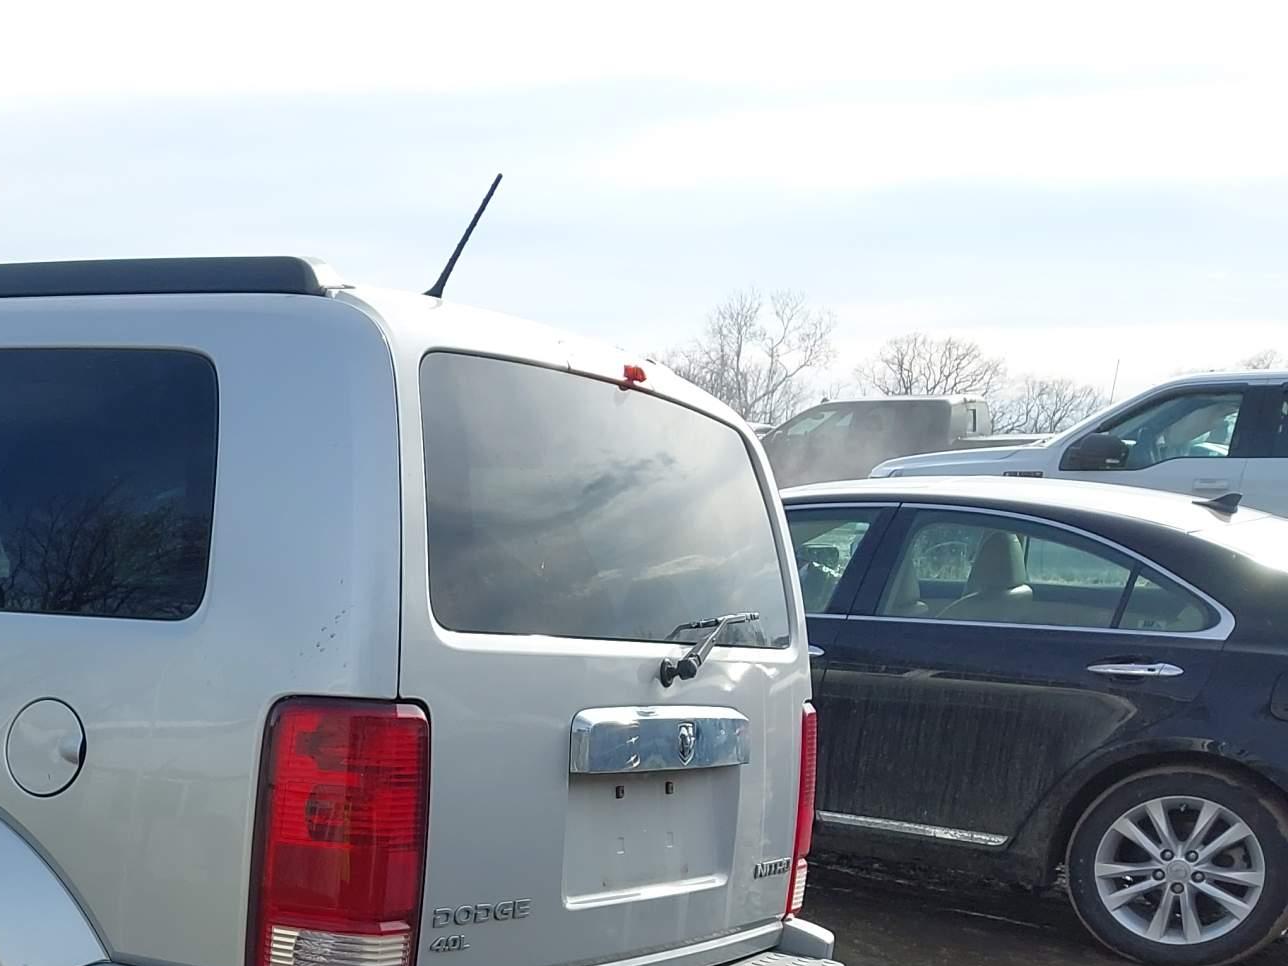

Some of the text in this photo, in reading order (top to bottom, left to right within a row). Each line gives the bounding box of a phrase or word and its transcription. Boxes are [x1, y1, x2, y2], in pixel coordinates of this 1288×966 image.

[753, 857, 792, 880] NITRO
[432, 898, 532, 929] DODGE
[429, 934, 471, 953] 4.0L
